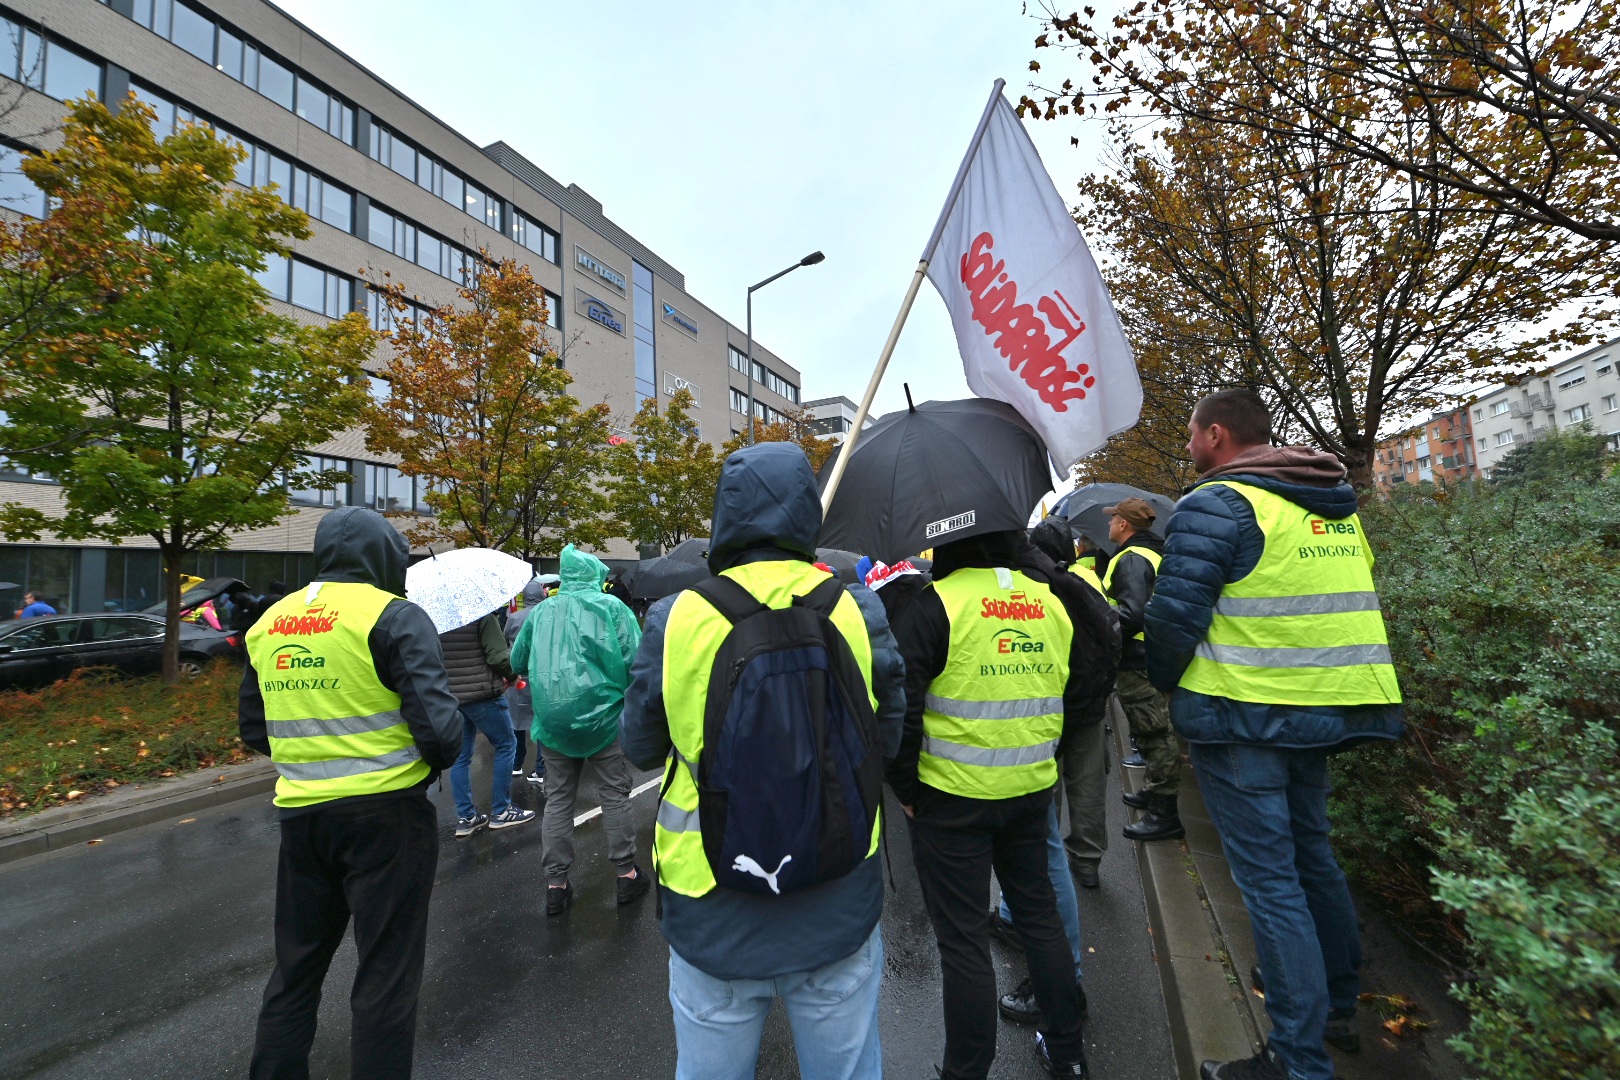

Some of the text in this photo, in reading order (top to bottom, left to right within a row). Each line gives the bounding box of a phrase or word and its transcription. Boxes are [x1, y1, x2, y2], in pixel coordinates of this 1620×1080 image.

[928, 512, 975, 536] SONAROL
[1311, 520, 1355, 535] Enea
[998, 638, 1044, 654] Enea
[276, 654, 325, 670] Enea
[980, 663, 1054, 676] BYDGOSZCZ
[264, 678, 340, 692] BYDGOSZCZ
